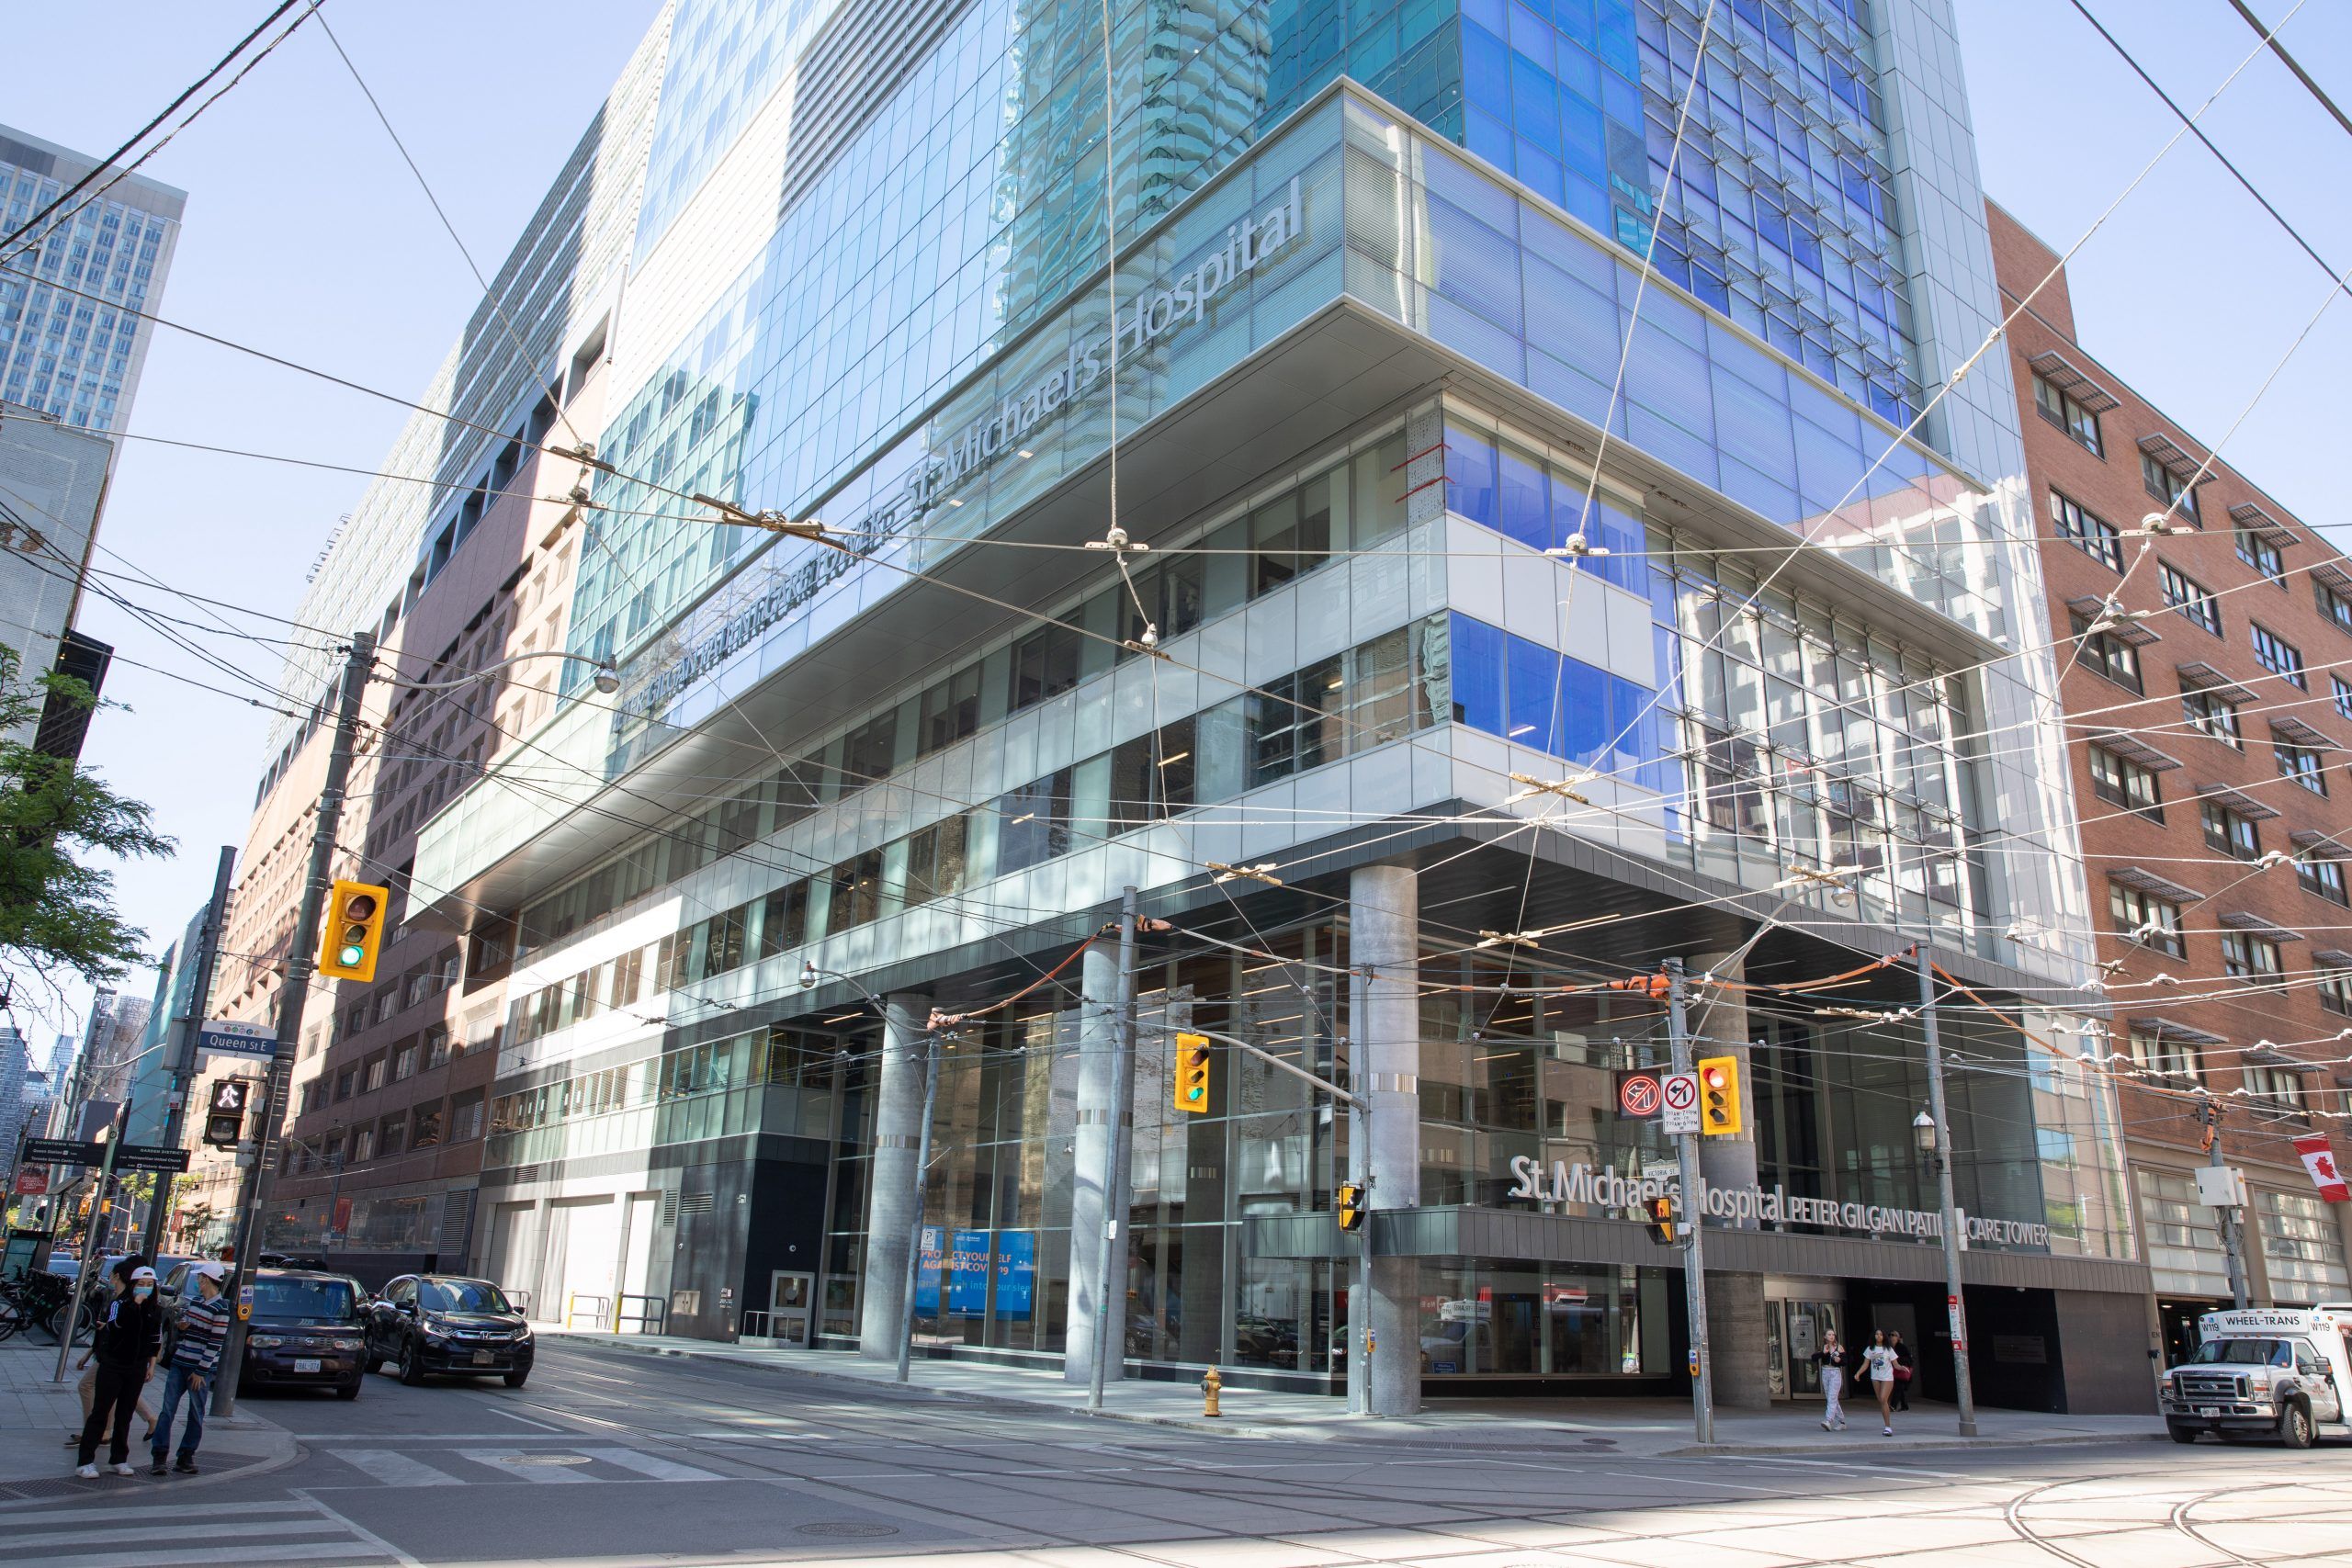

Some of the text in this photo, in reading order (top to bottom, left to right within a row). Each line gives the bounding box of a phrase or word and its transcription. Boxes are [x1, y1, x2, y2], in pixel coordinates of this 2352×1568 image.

[939, 340, 1102, 490] Michael's
[1113, 175, 1302, 366] Hospital
[209, 1034, 267, 1051] Queen St E
[1790, 1196, 1841, 1227] PETER
[1841, 1202, 1904, 1234] GILGAN
[1966, 1216, 2003, 1242] CARE
[2005, 1221, 2050, 1247] TOWER
[2224, 1315, 2301, 1325] WHEEL-TRANS
[2201, 1323, 2220, 1332] W119
[2311, 1323, 2331, 1332] W119
